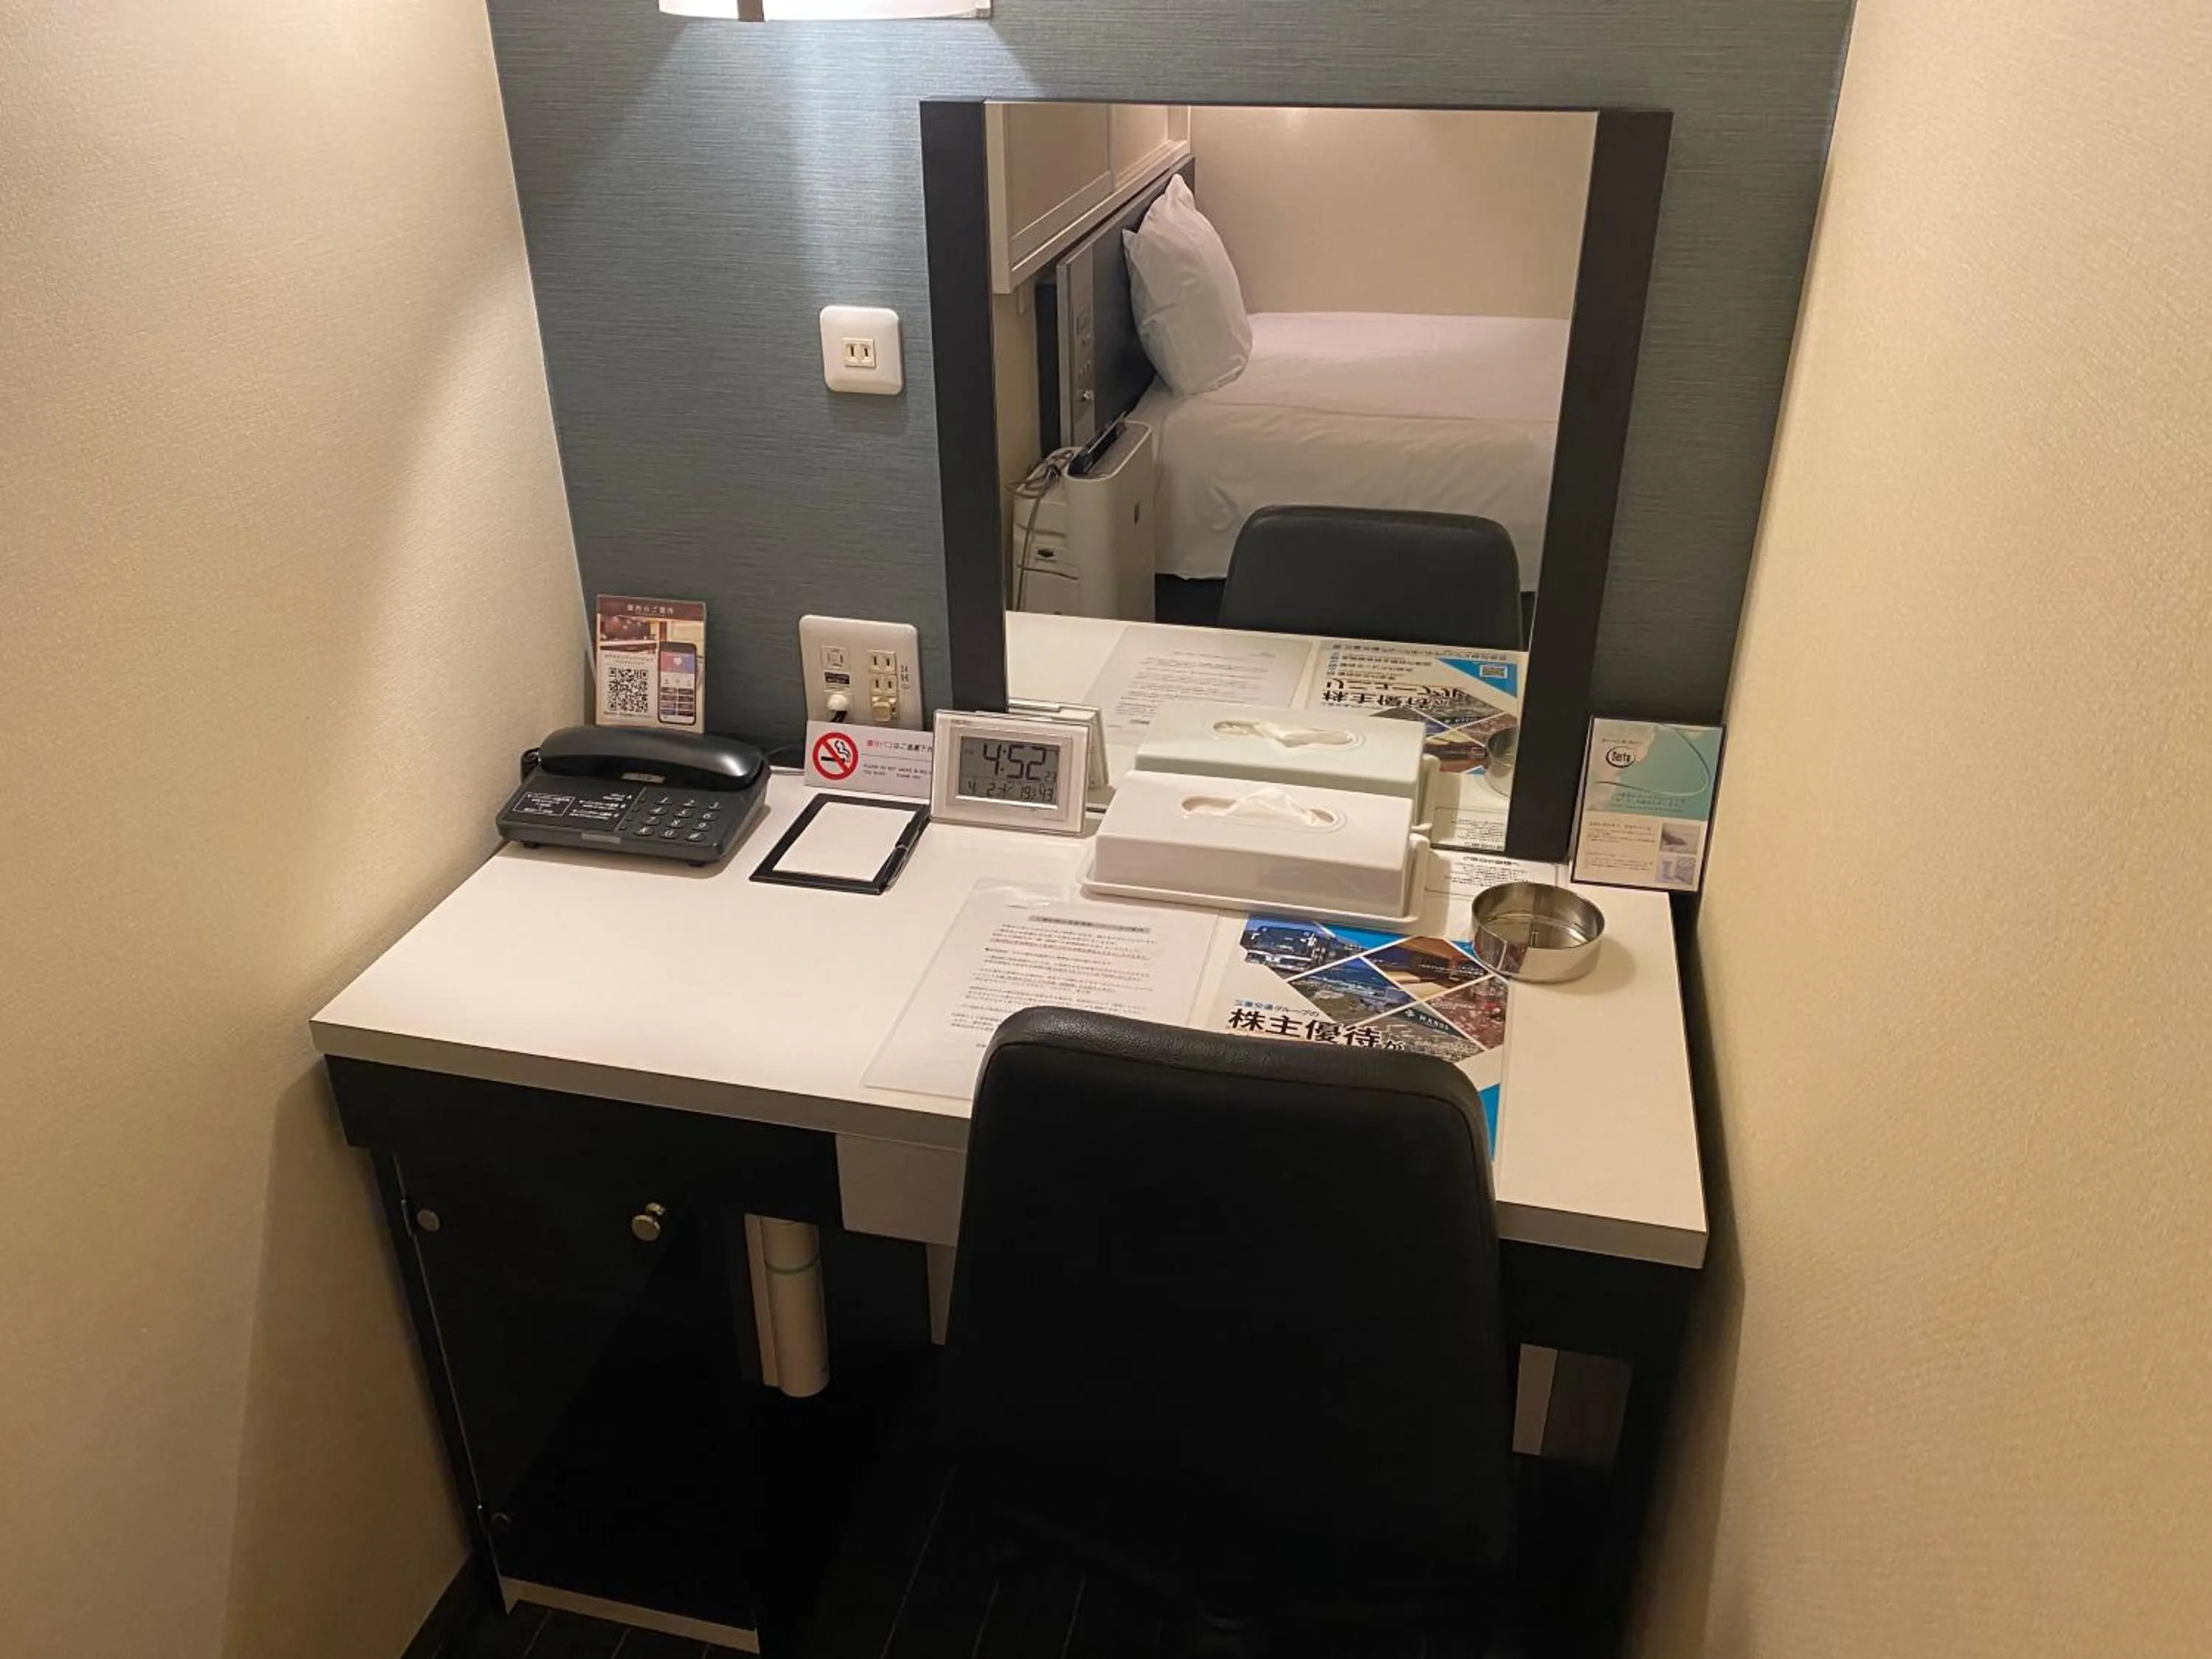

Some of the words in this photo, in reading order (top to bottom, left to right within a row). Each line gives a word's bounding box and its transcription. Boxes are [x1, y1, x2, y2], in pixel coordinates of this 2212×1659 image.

[982, 742, 1046, 782] 4:52
[1228, 1007, 1405, 1050] 株主優待が
